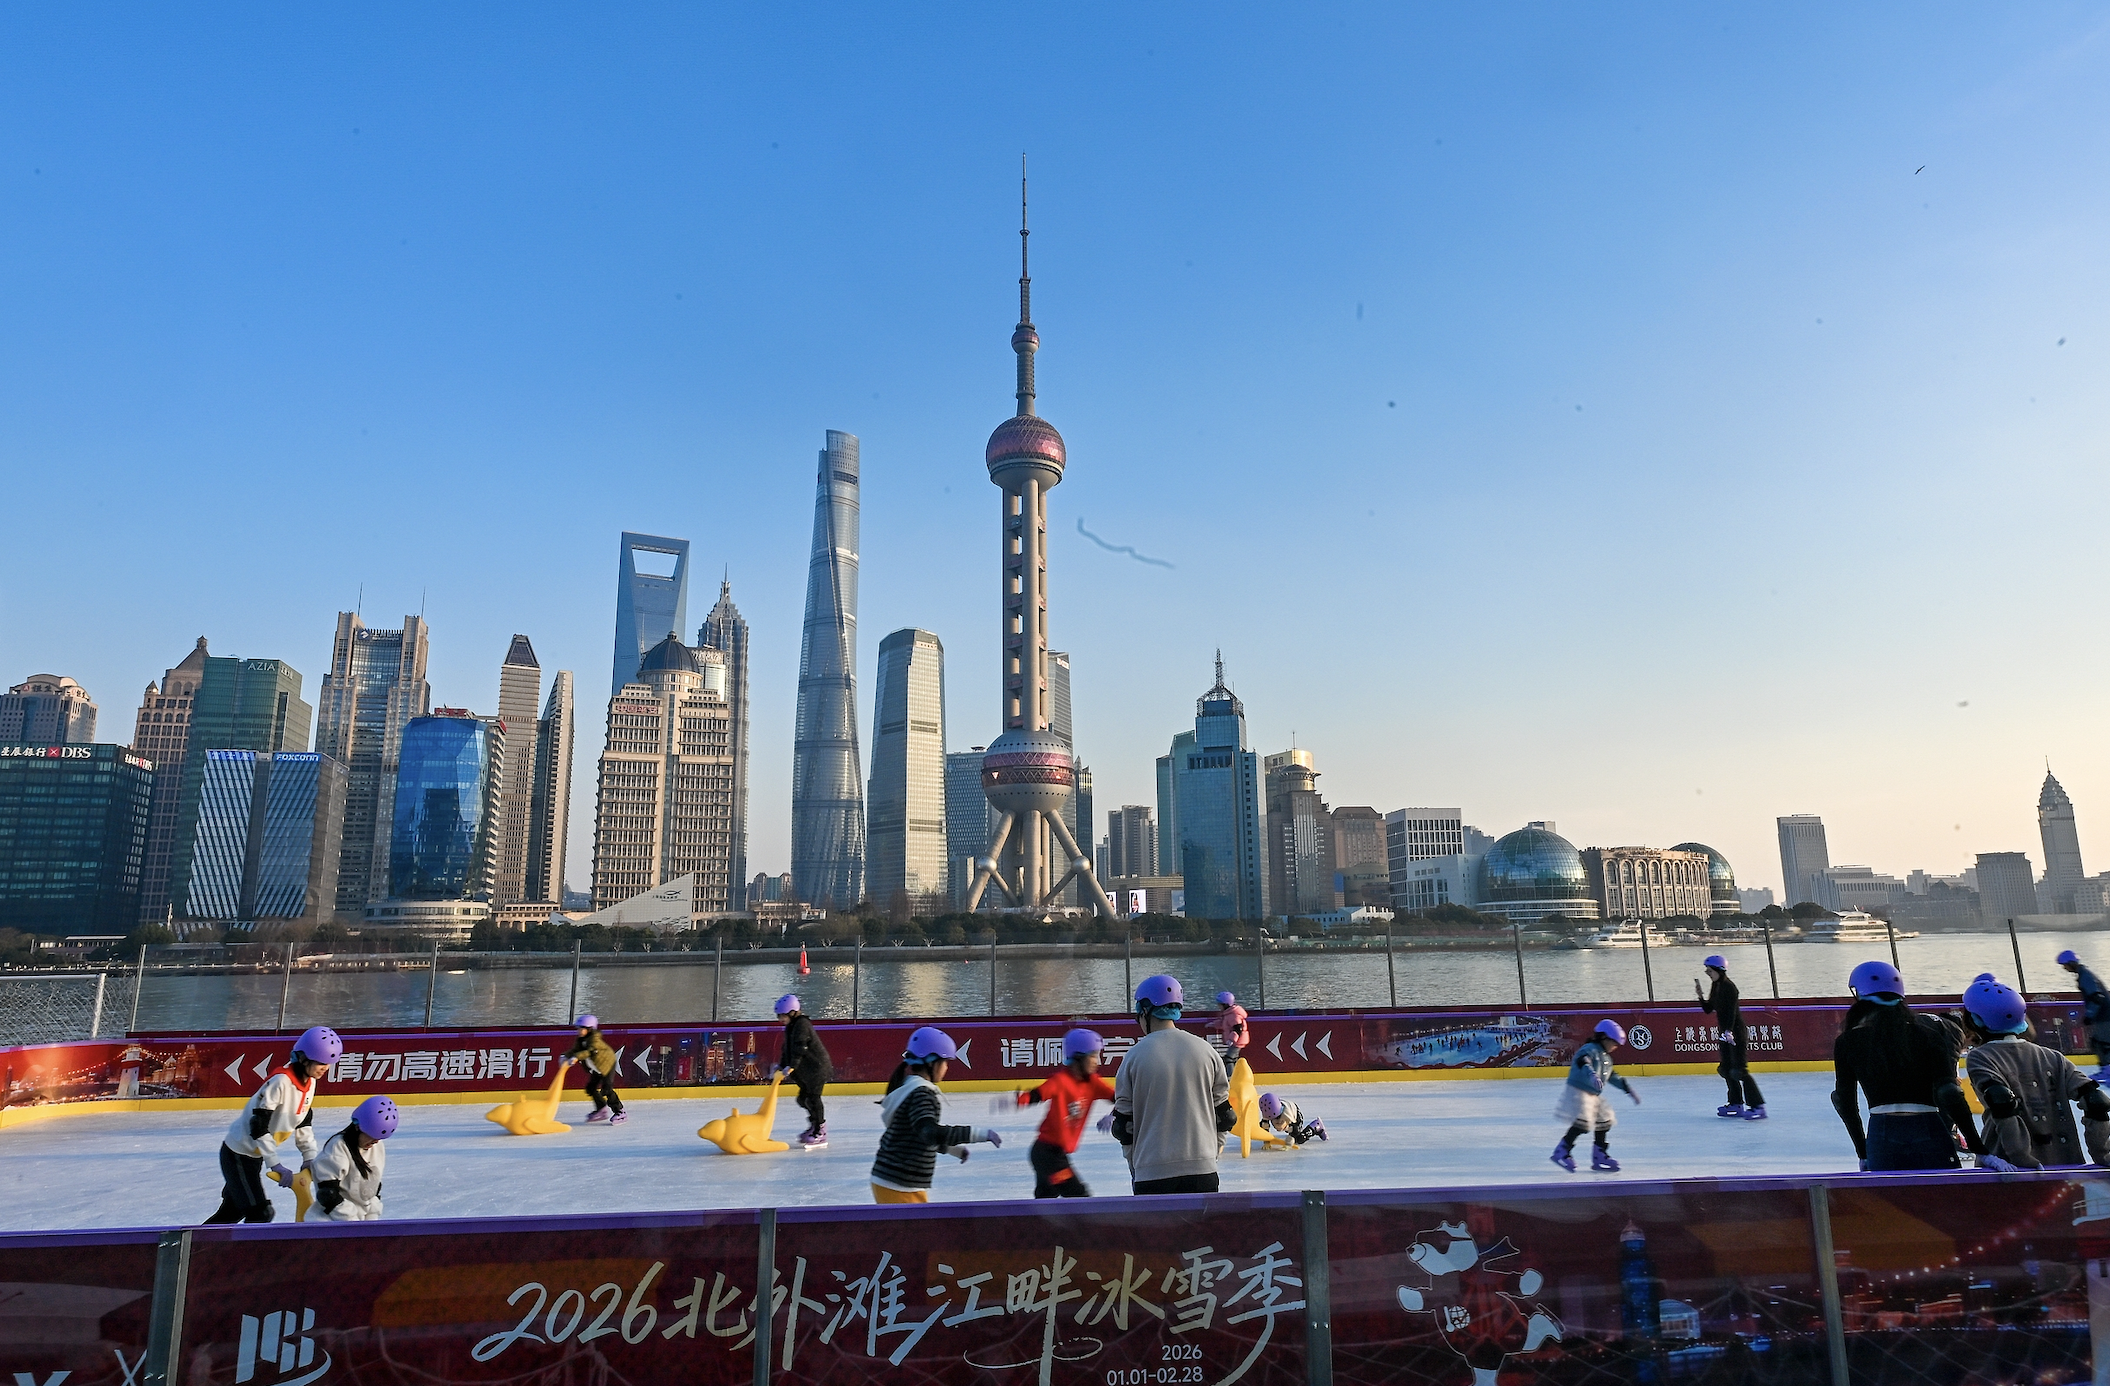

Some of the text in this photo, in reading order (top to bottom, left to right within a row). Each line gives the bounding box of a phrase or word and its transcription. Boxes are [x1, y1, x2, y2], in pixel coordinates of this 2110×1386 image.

[247, 662, 276, 671] AZIA
[61, 746, 92, 758] DBS
[1761, 1042, 1784, 1050] CLUB
[328, 1047, 553, 1083] 请勿高速滑行
[1162, 1344, 1203, 1361] 2026
[1106, 1366, 1204, 1386] 01.01-02.28
